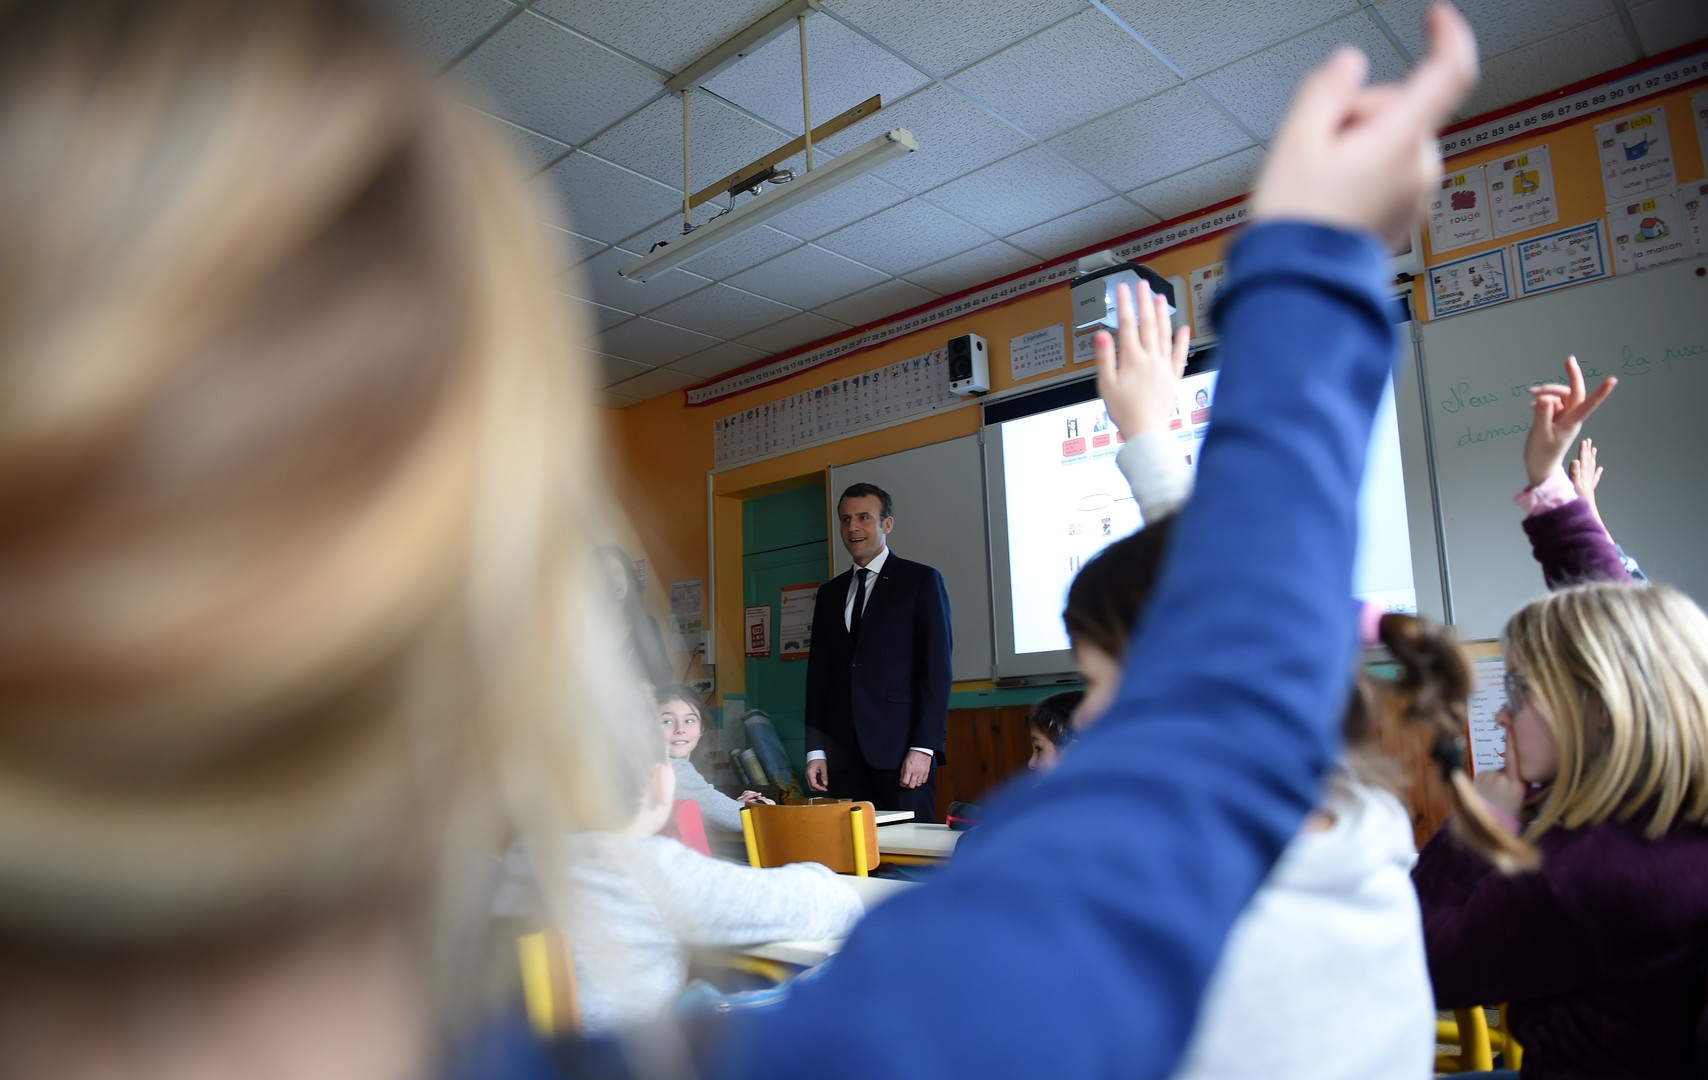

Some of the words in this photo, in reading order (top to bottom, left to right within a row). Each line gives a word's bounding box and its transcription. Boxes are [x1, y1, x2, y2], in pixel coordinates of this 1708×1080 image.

[1444, 141, 1456, 151] 80
[1460, 136, 1471, 146] 81
[1475, 131, 1488, 141] 82
[1491, 126, 1504, 136] 83
[1507, 121, 1520, 131] 84
[1524, 115, 1537, 126] 85
[1540, 110, 1554, 120] 86
[1558, 104, 1571, 115] 87
[1574, 99, 1588, 110] 88
[1592, 94, 1606, 105] 89
[1609, 88, 1623, 99] 90
[1627, 82, 1640, 93] 91
[1645, 76, 1660, 88] 92
[1663, 70, 1679, 82] 93
[1682, 64, 1697, 76] 94
[1700, 60, 1708, 70] 9
[1620, 166, 1637, 175] une
[1640, 158, 1669, 172] poche
[1526, 196, 1550, 210] girafe
[1450, 212, 1480, 224] rouge
[1120, 248, 1130, 256] 55
[1132, 244, 1141, 253] 56
[1143, 240, 1152, 249] 57
[1154, 236, 1164, 245] 58
[1165, 233, 1175, 241] 59
[1177, 229, 1187, 237] 60
[1189, 225, 1198, 233] 61
[1200, 221, 1211, 229] 62
[1213, 217, 1223, 225] 63
[1225, 212, 1235, 221] 64
[1237, 208, 1248, 217] 65
[1570, 235, 1594, 246] pigeon
[1646, 242, 1682, 256] maison
[945, 307, 952, 315] 37
[963, 301, 970, 309] 39
[1068, 266, 1076, 274] 50
[1441, 382, 1498, 413] Nous
[1620, 344, 1652, 368] la
[1457, 415, 1530, 446] demai
